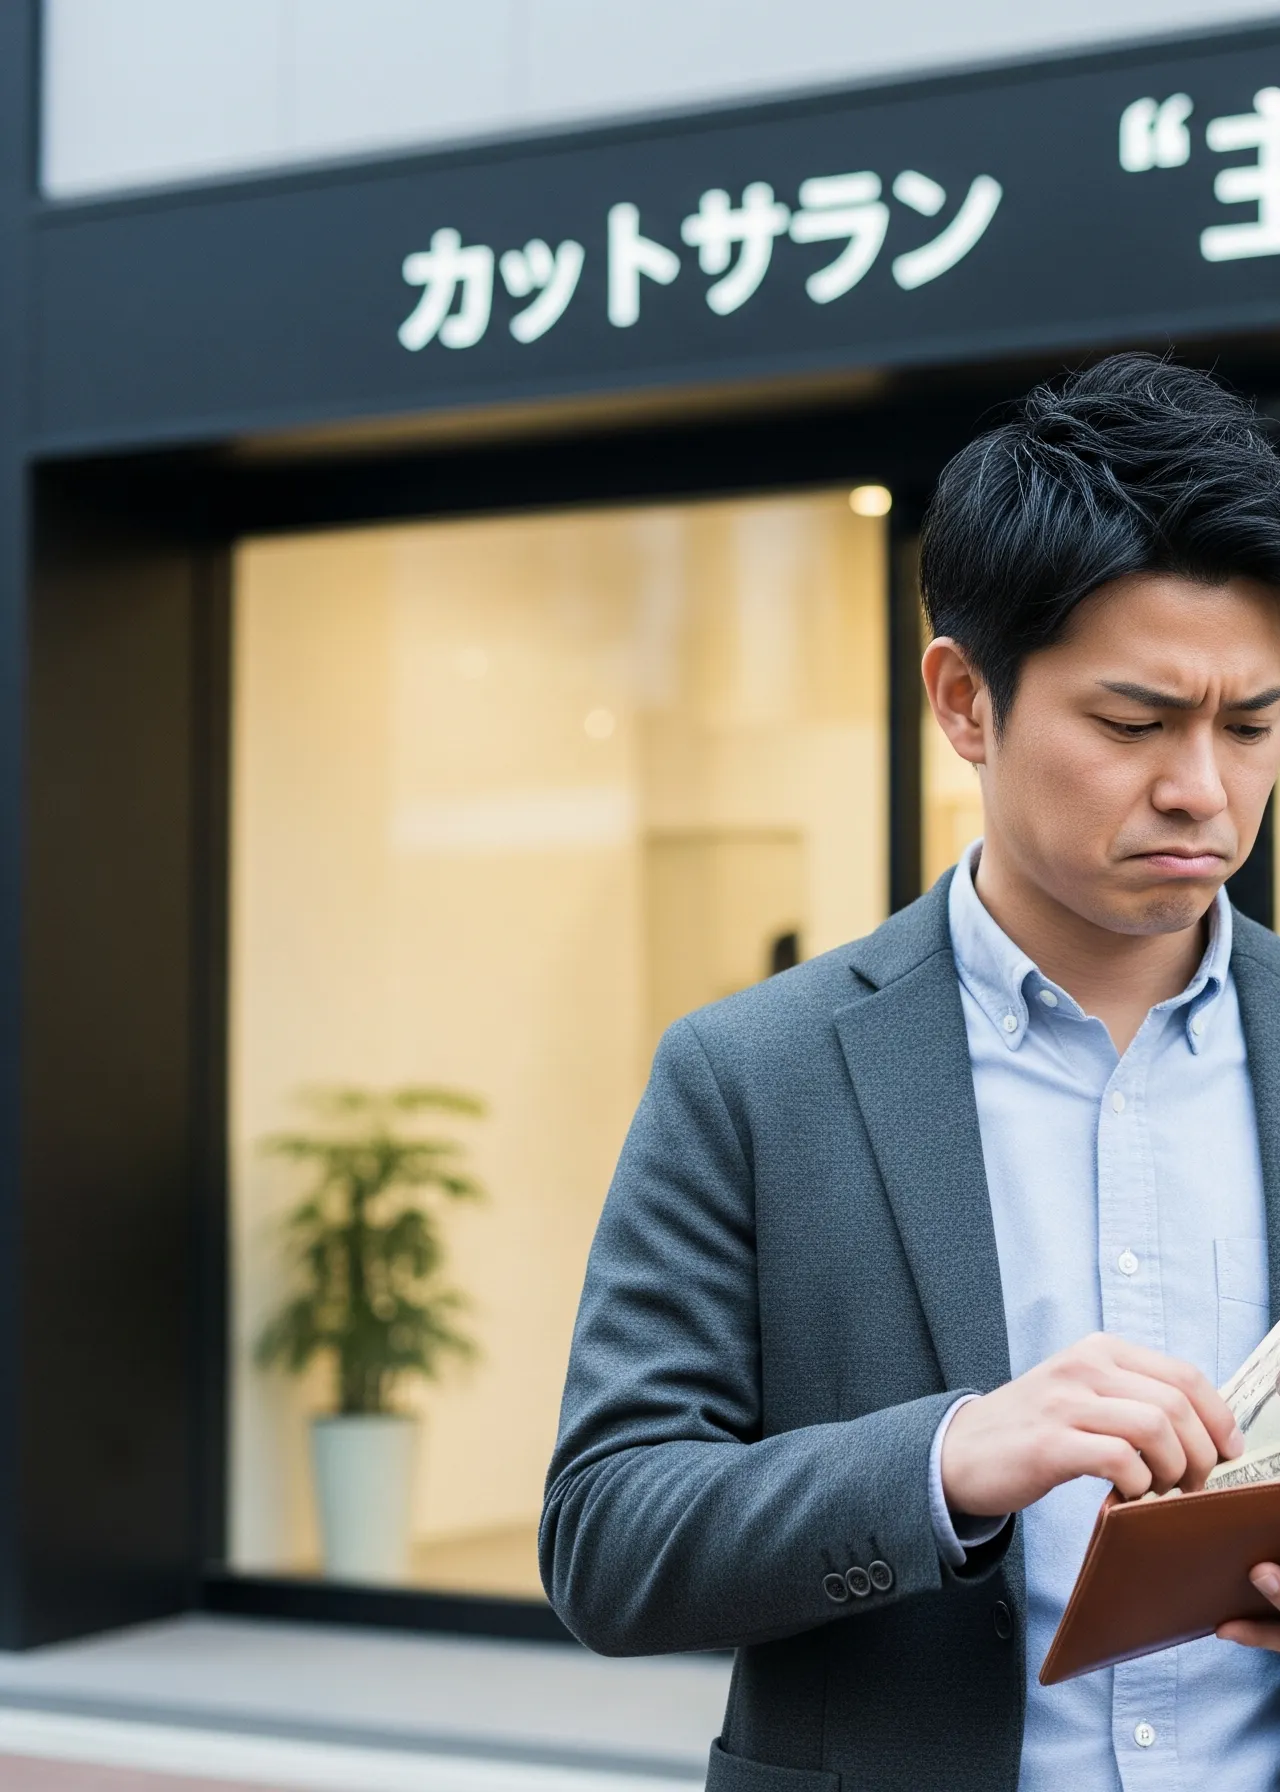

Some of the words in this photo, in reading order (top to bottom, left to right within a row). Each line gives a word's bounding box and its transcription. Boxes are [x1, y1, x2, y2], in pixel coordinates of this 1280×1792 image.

[398, 170, 1002, 351] カットサラン
